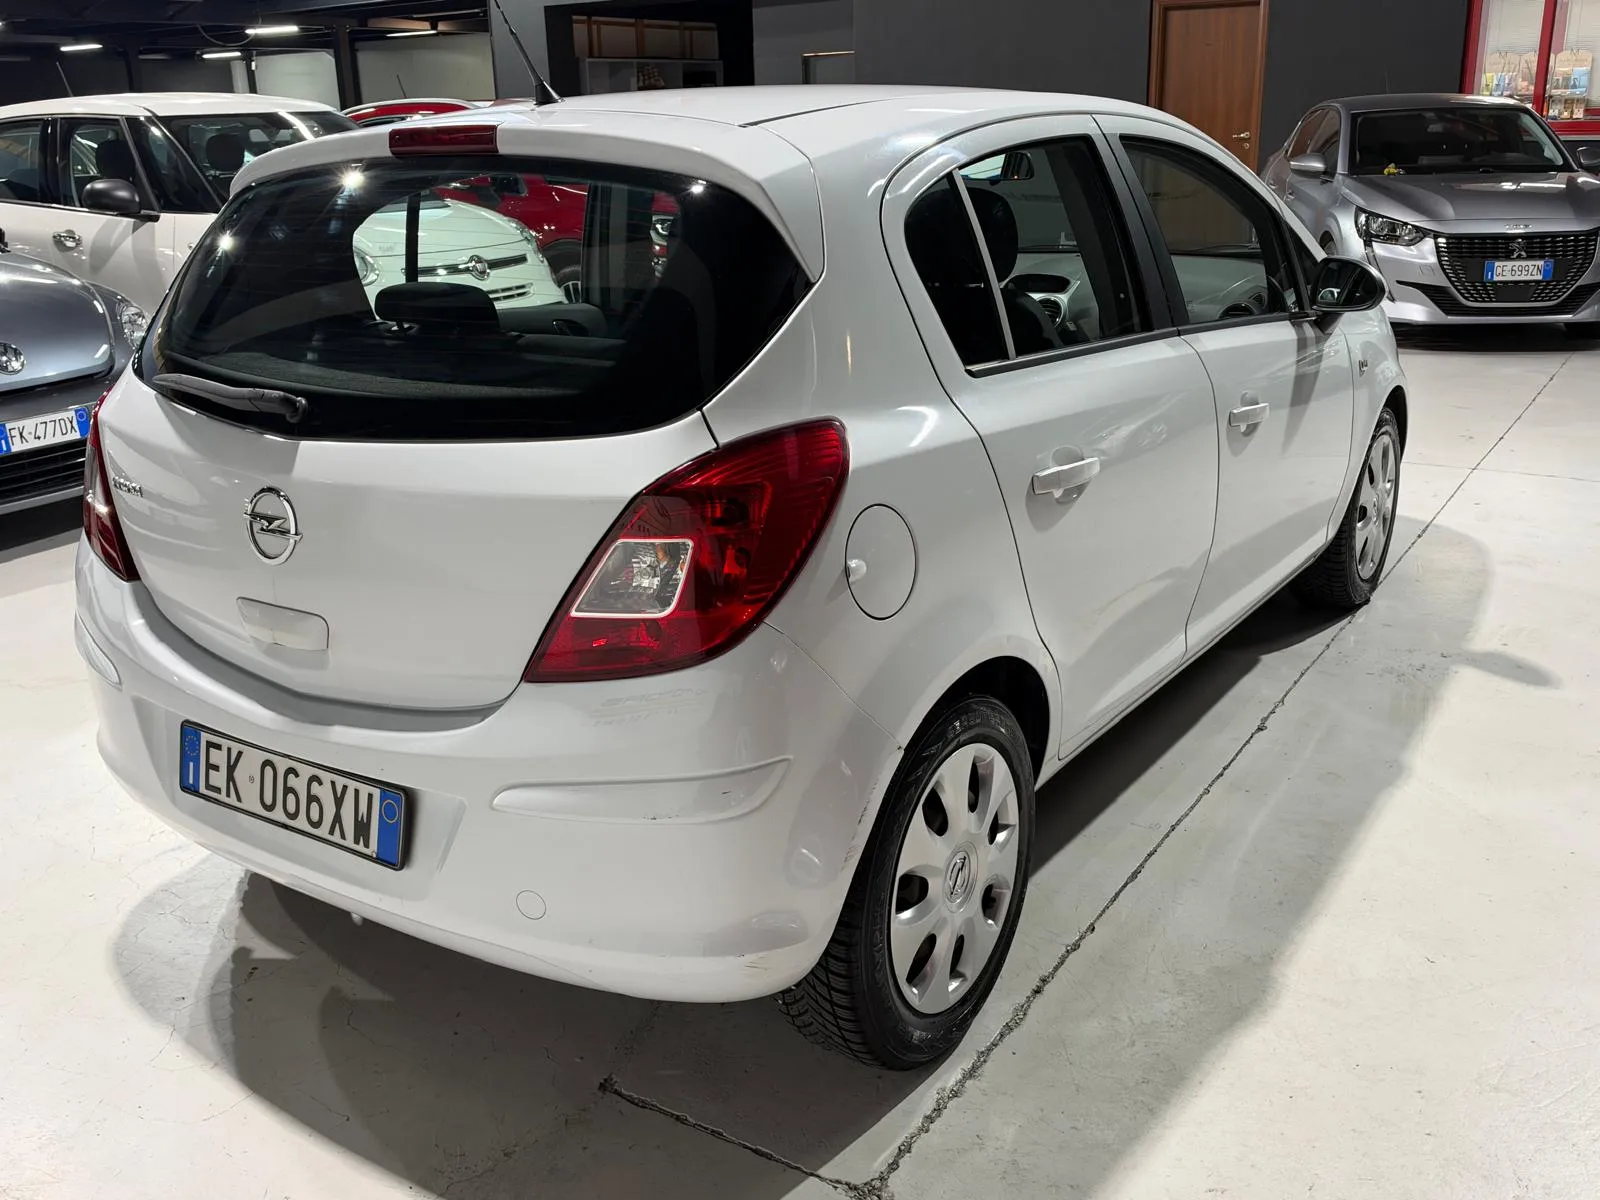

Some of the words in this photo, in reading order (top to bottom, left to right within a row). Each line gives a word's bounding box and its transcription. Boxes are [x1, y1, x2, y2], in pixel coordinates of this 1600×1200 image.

[1510, 264, 1543, 277] 699ZN
[8, 425, 29, 446] FK
[33, 415, 78, 441] 477DX
[203, 739, 243, 804] EK
[258, 758, 374, 850] 066XW
